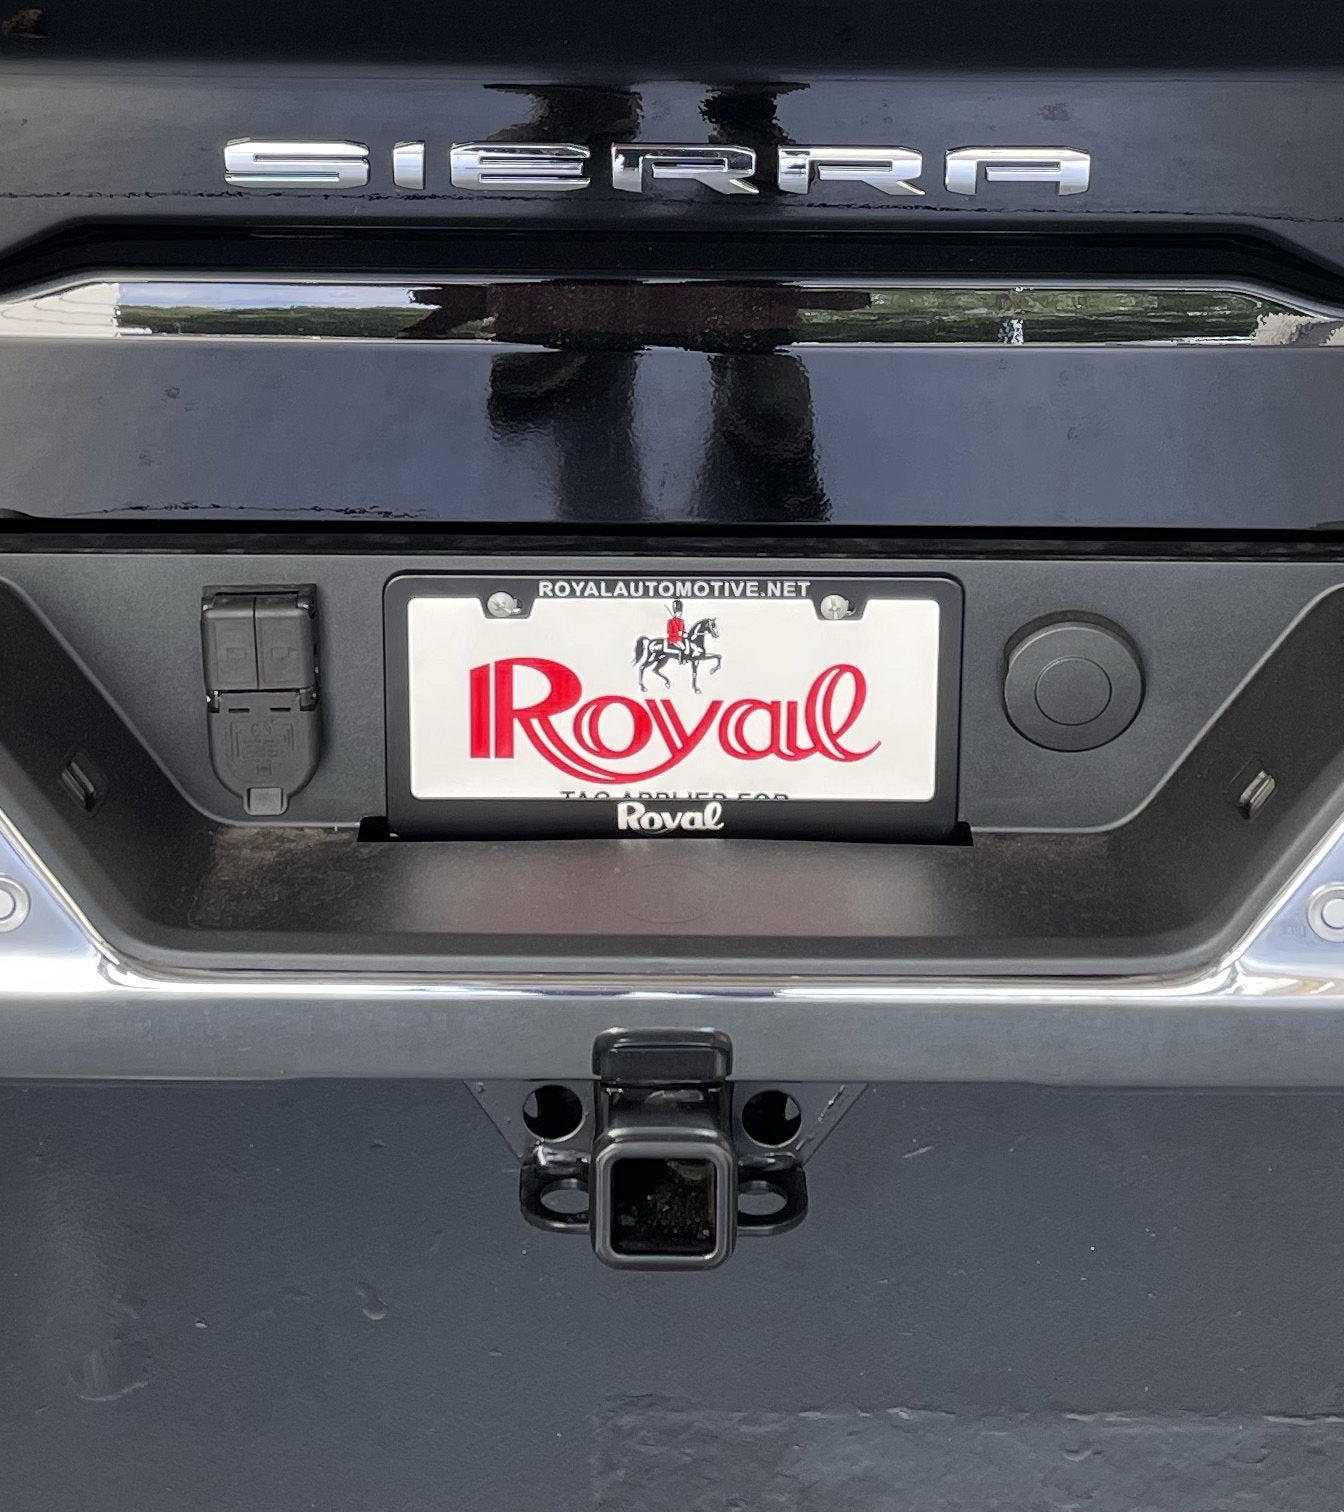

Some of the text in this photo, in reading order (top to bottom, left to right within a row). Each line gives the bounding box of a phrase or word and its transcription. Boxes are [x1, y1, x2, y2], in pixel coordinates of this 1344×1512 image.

[223, 139, 1093, 196] SIERRA
[538, 580, 811, 598] ROYALAUTOMOTIVE.NET
[469, 656, 882, 785] Royal
[617, 801, 725, 834] Royal
